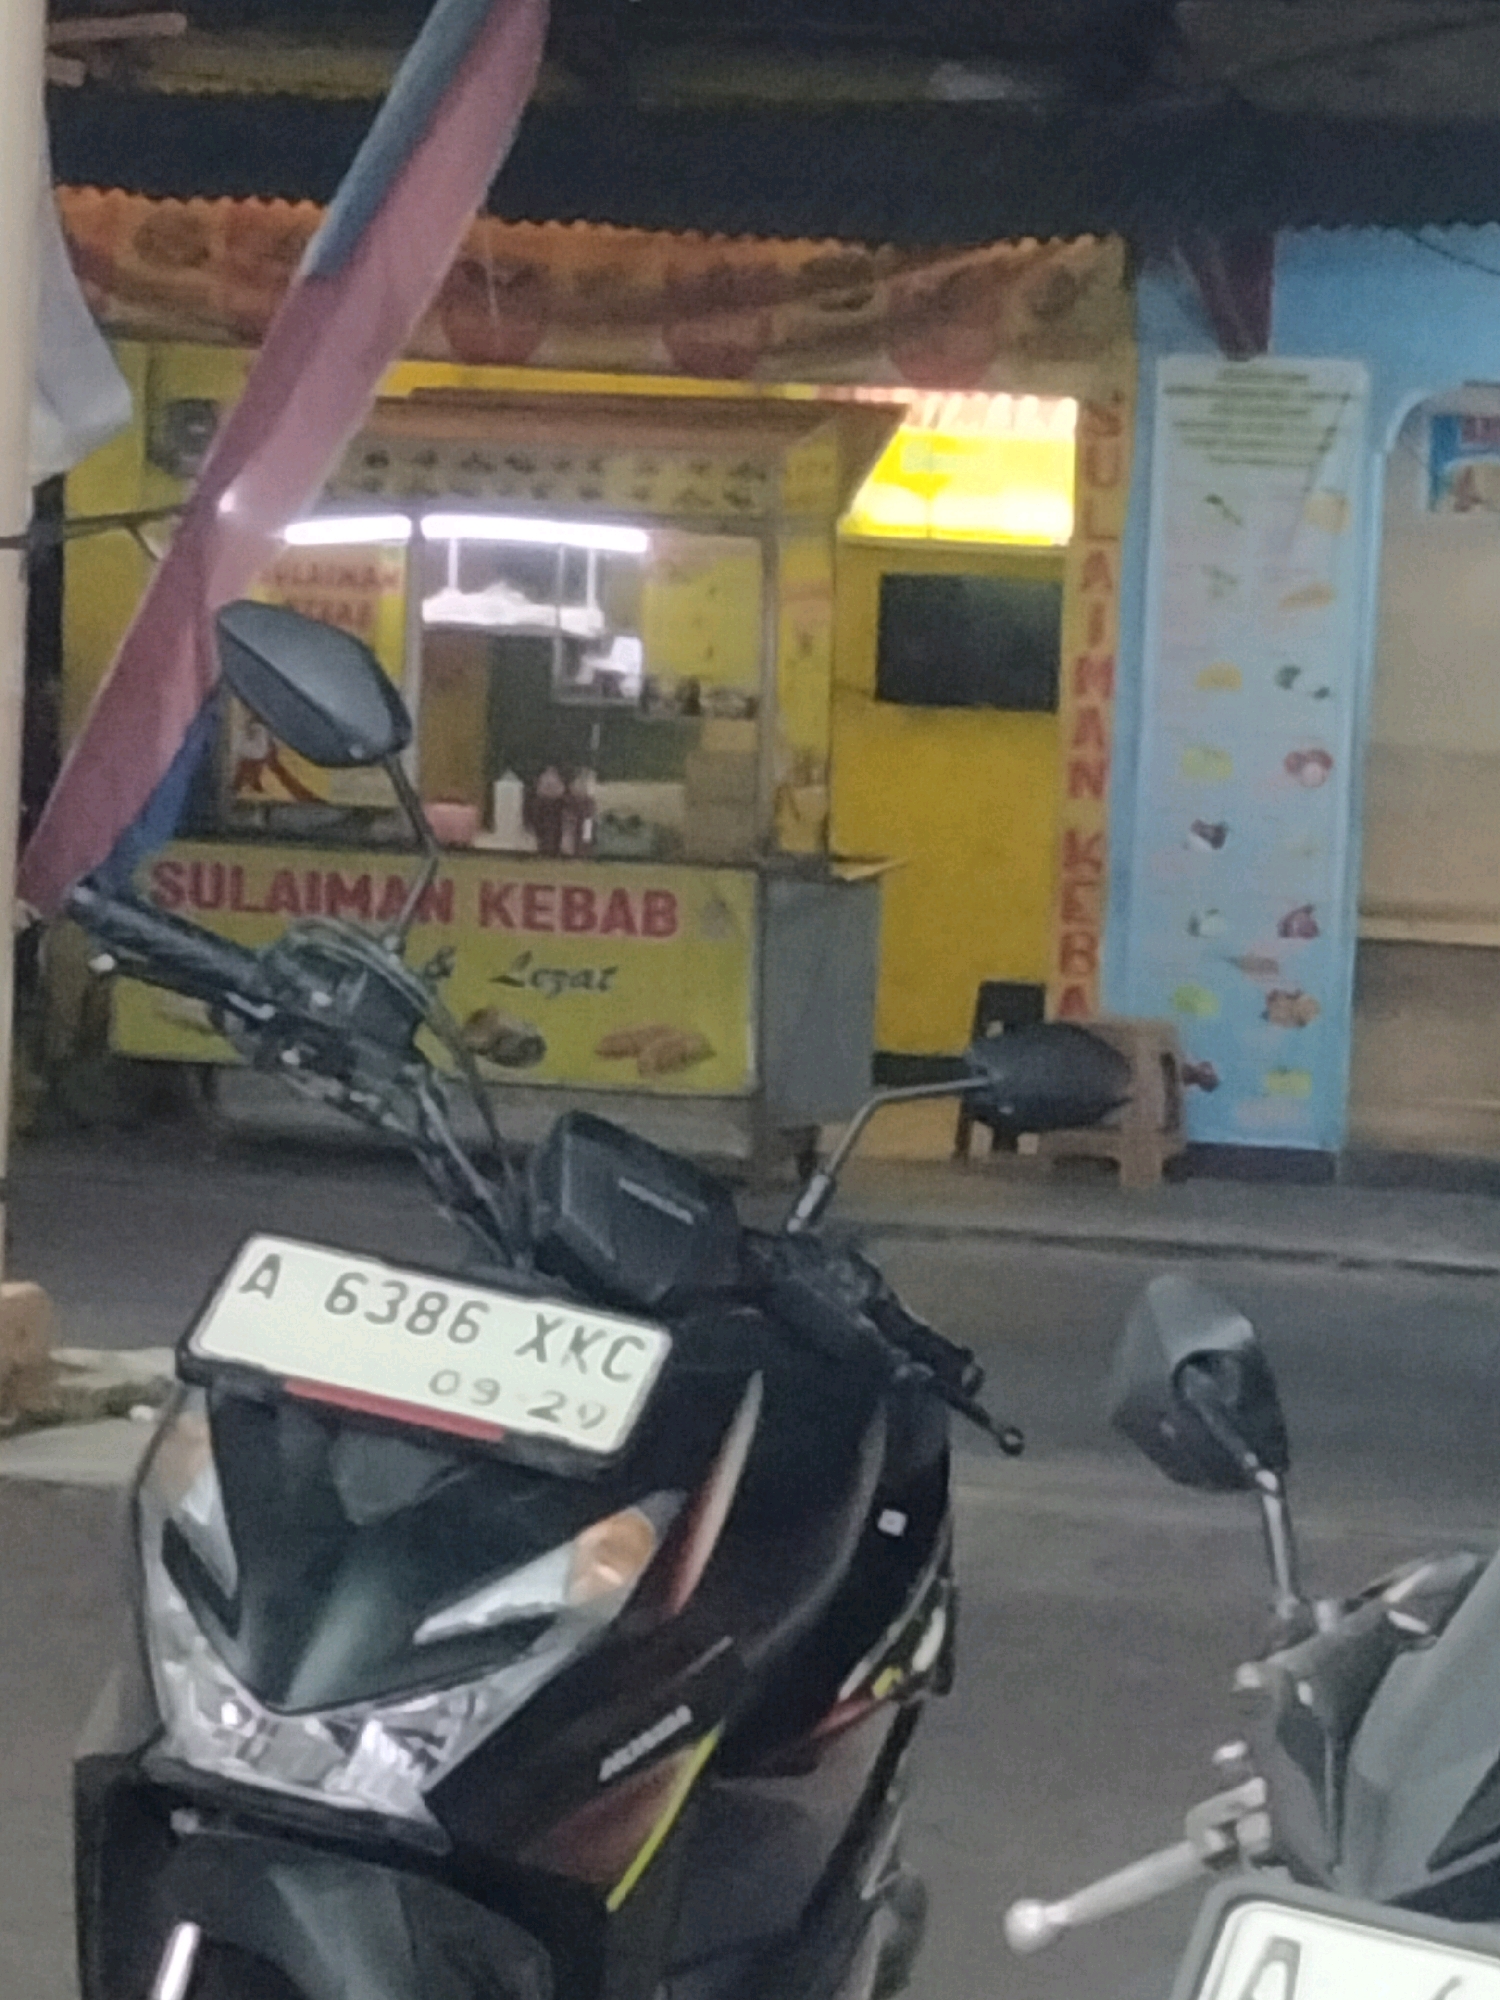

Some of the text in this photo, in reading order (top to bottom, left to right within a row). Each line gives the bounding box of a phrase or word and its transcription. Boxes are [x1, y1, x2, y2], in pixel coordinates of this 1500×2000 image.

[152, 861, 678, 938] SULAIMAN KEBAB
[239, 1253, 646, 1382] A 6386 XKC
[428, 1369, 501, 1407] 09
